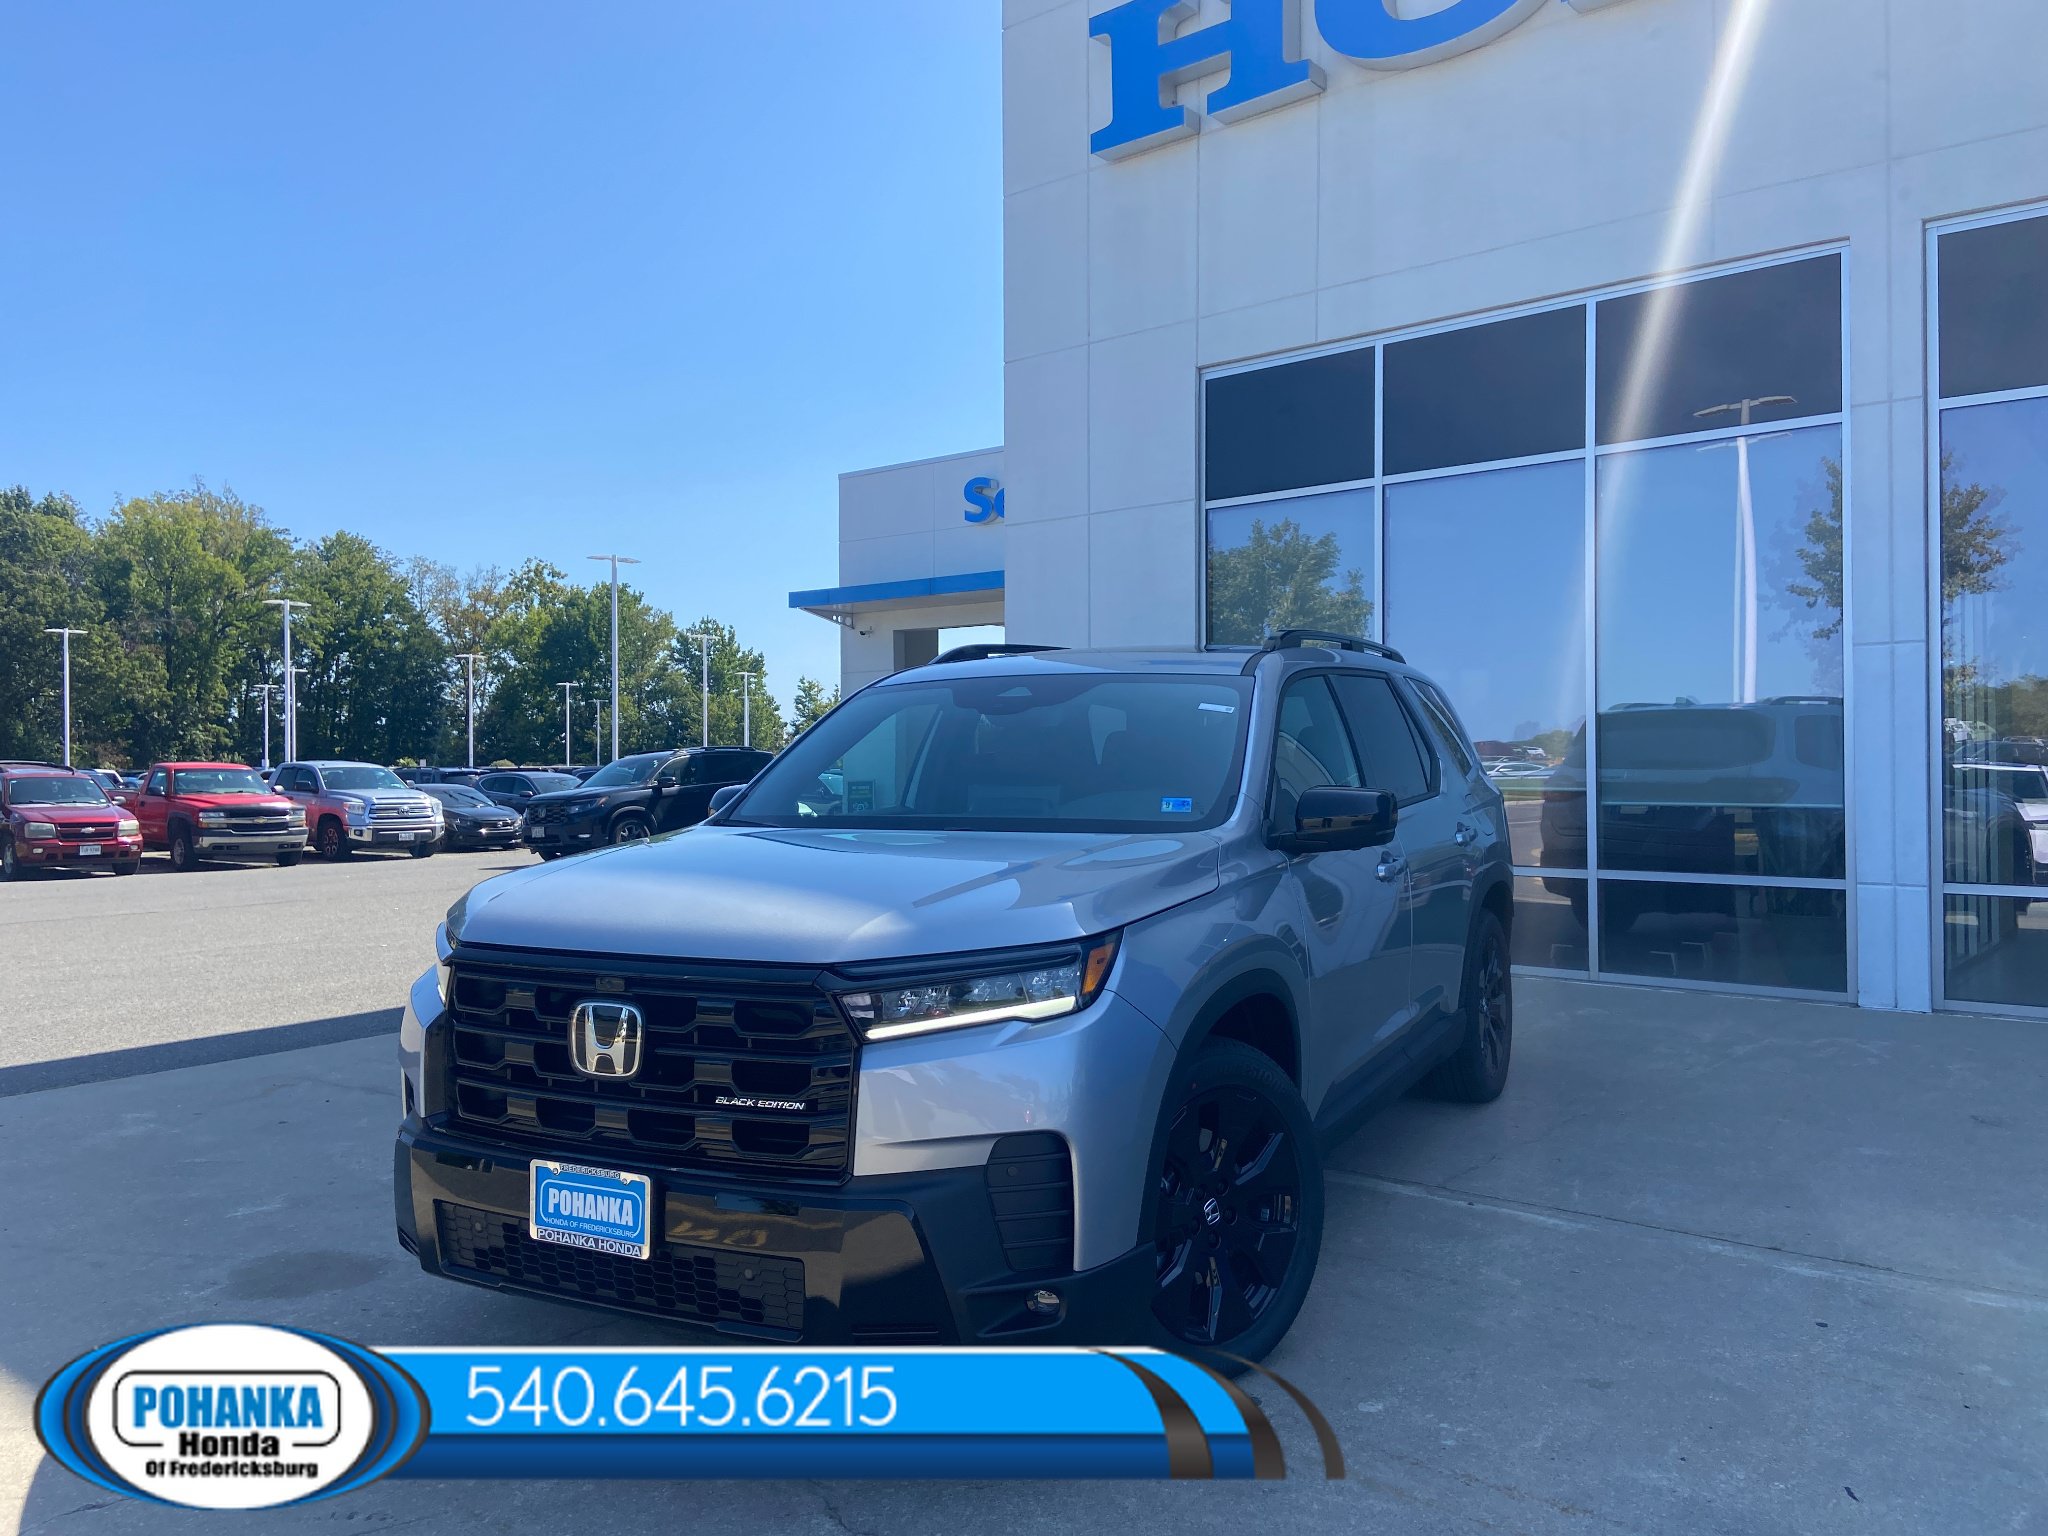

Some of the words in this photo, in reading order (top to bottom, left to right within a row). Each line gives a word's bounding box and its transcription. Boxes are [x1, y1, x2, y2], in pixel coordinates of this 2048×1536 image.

[715, 1096, 755, 1107] BLACK
[757, 1100, 805, 1110] EDITION
[560, 1164, 621, 1179] FREDERICKSBURG
[548, 1187, 634, 1227] POHANKA
[545, 1216, 569, 1227] HONDA
[569, 1220, 580, 1228] OF
[579, 1222, 636, 1239] FREDERICKSBURG
[537, 1228, 596, 1249] POHANKA
[598, 1239, 642, 1257] HONDA
